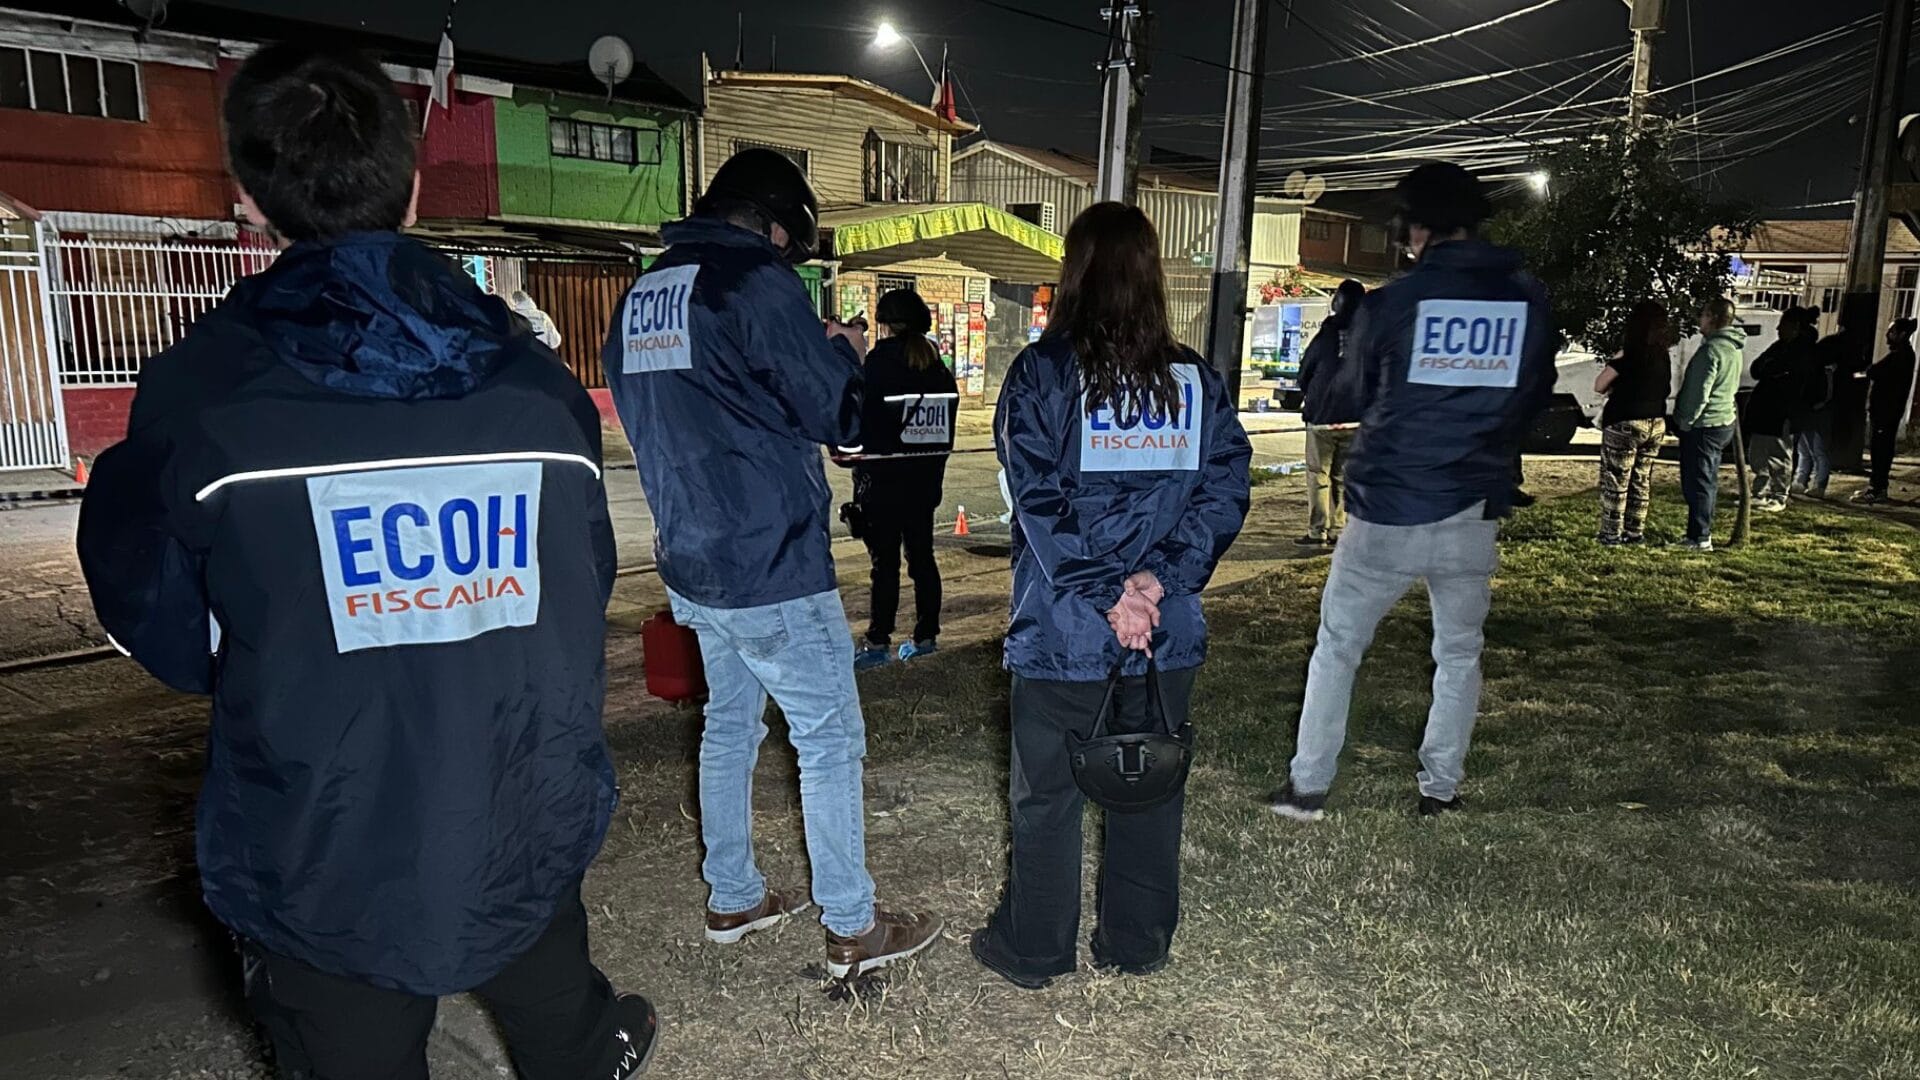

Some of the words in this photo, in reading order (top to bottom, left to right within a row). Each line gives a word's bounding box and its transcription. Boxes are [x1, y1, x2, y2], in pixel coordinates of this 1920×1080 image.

[629, 284, 687, 335] ECOH
[628, 334, 684, 353] FISCALIA
[1422, 316, 1518, 356] ECOH
[1419, 357, 1509, 370] FISCALIA
[1090, 434, 1189, 450] FISCALIA
[331, 493, 528, 588] ECOH
[345, 575, 526, 617] FISCALIA
